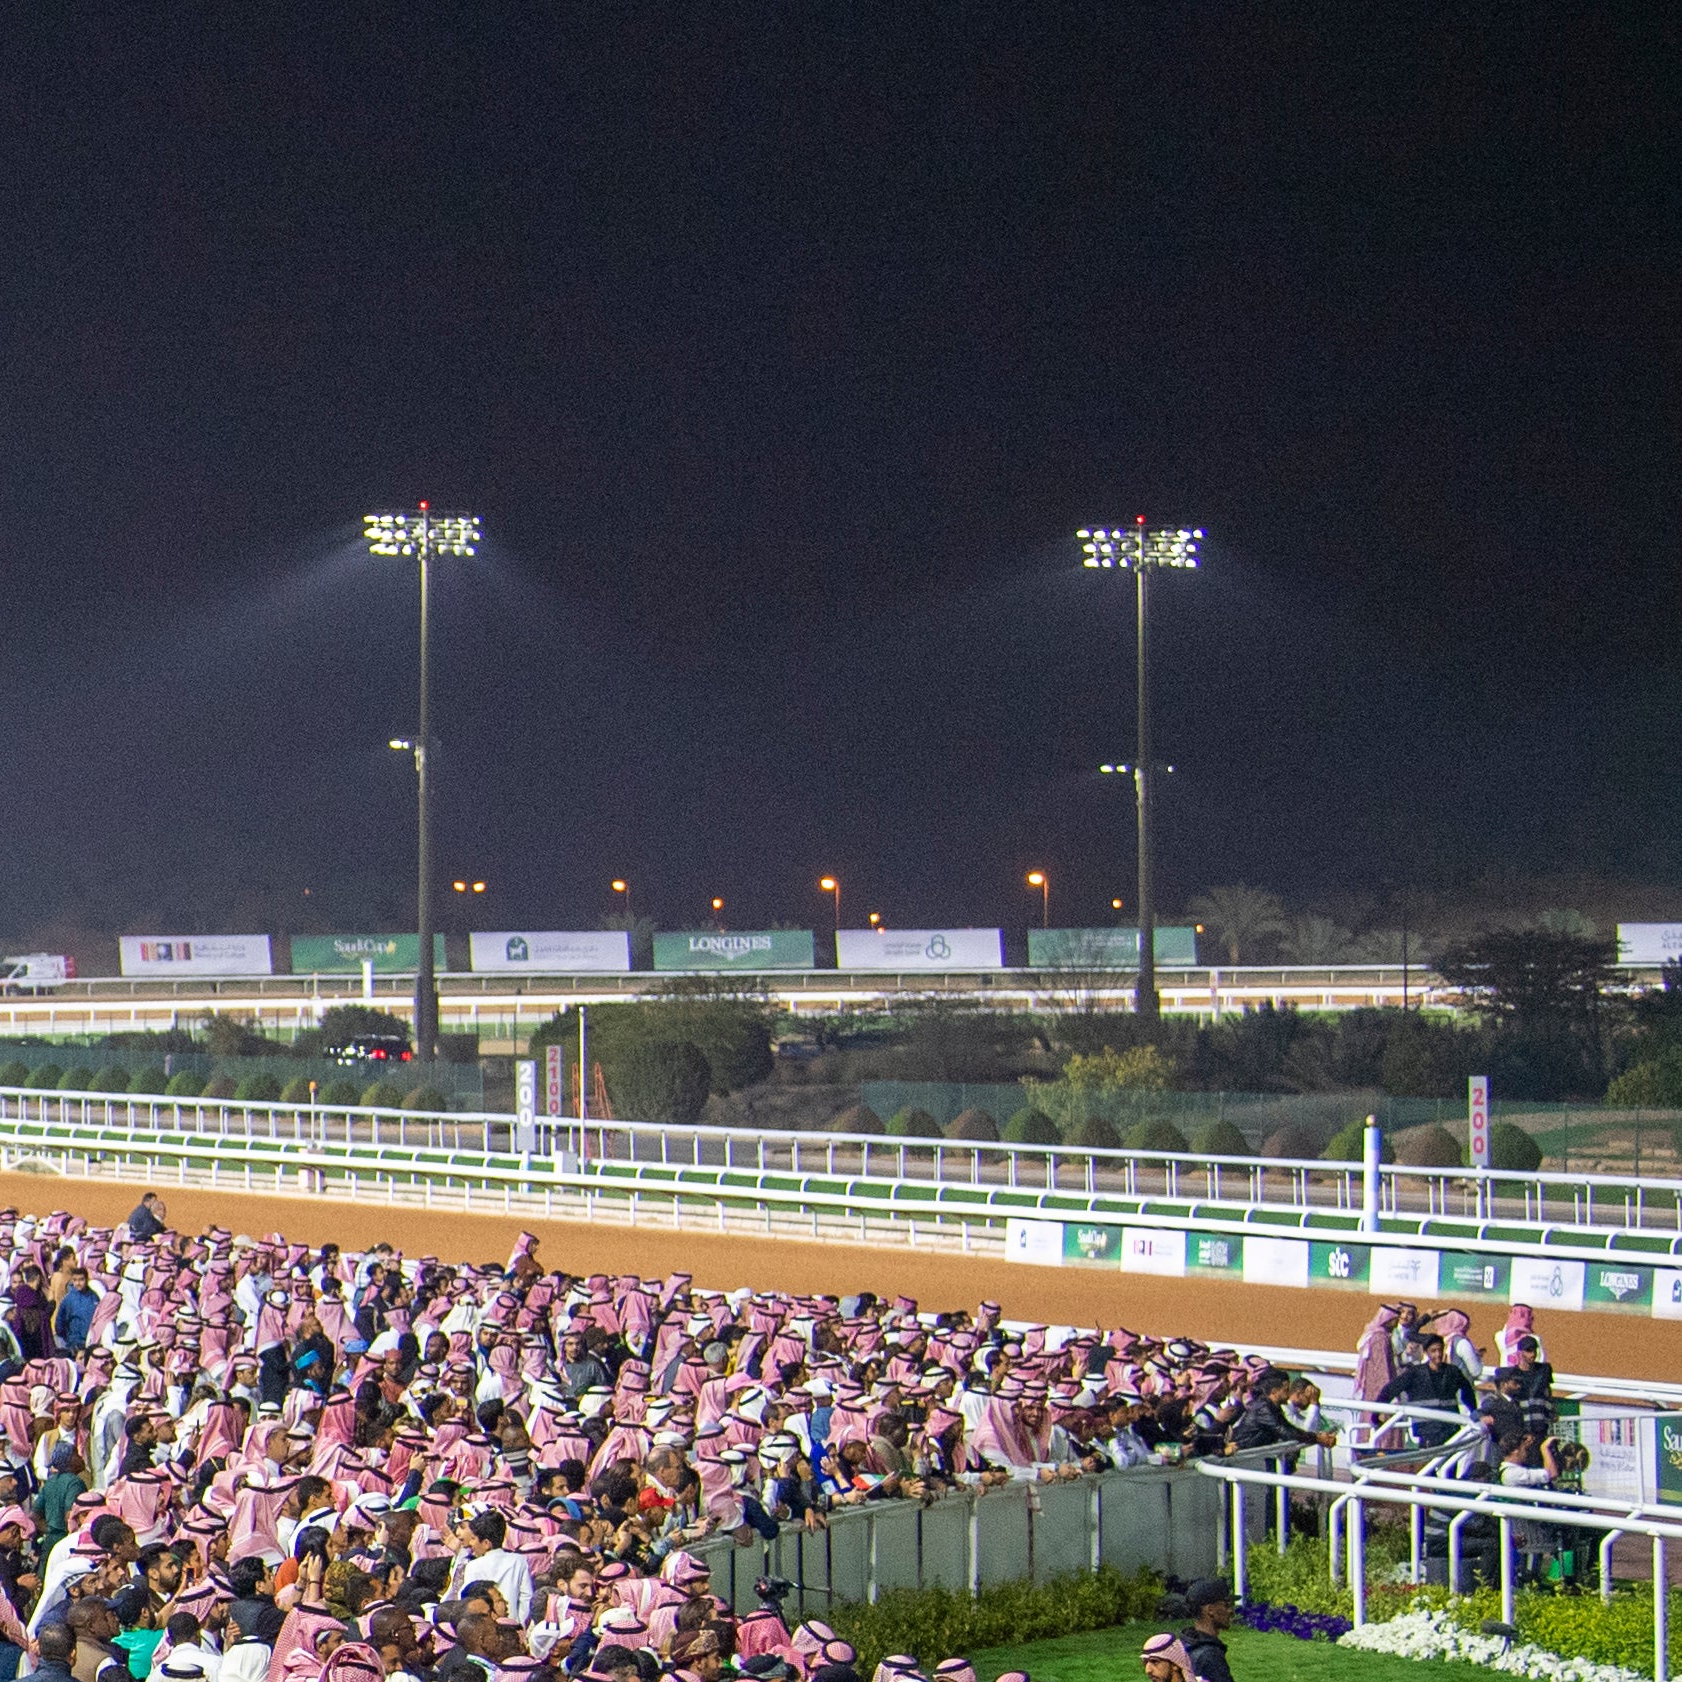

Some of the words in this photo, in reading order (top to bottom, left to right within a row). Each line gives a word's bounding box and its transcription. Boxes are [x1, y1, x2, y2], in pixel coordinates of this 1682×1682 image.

[688, 936, 772, 951] LONGINES
[519, 1063, 532, 1127] 200
[549, 1047, 558, 1113] 2100
[1472, 1088, 1484, 1154] 200
[1328, 1247, 1350, 1277] stc
